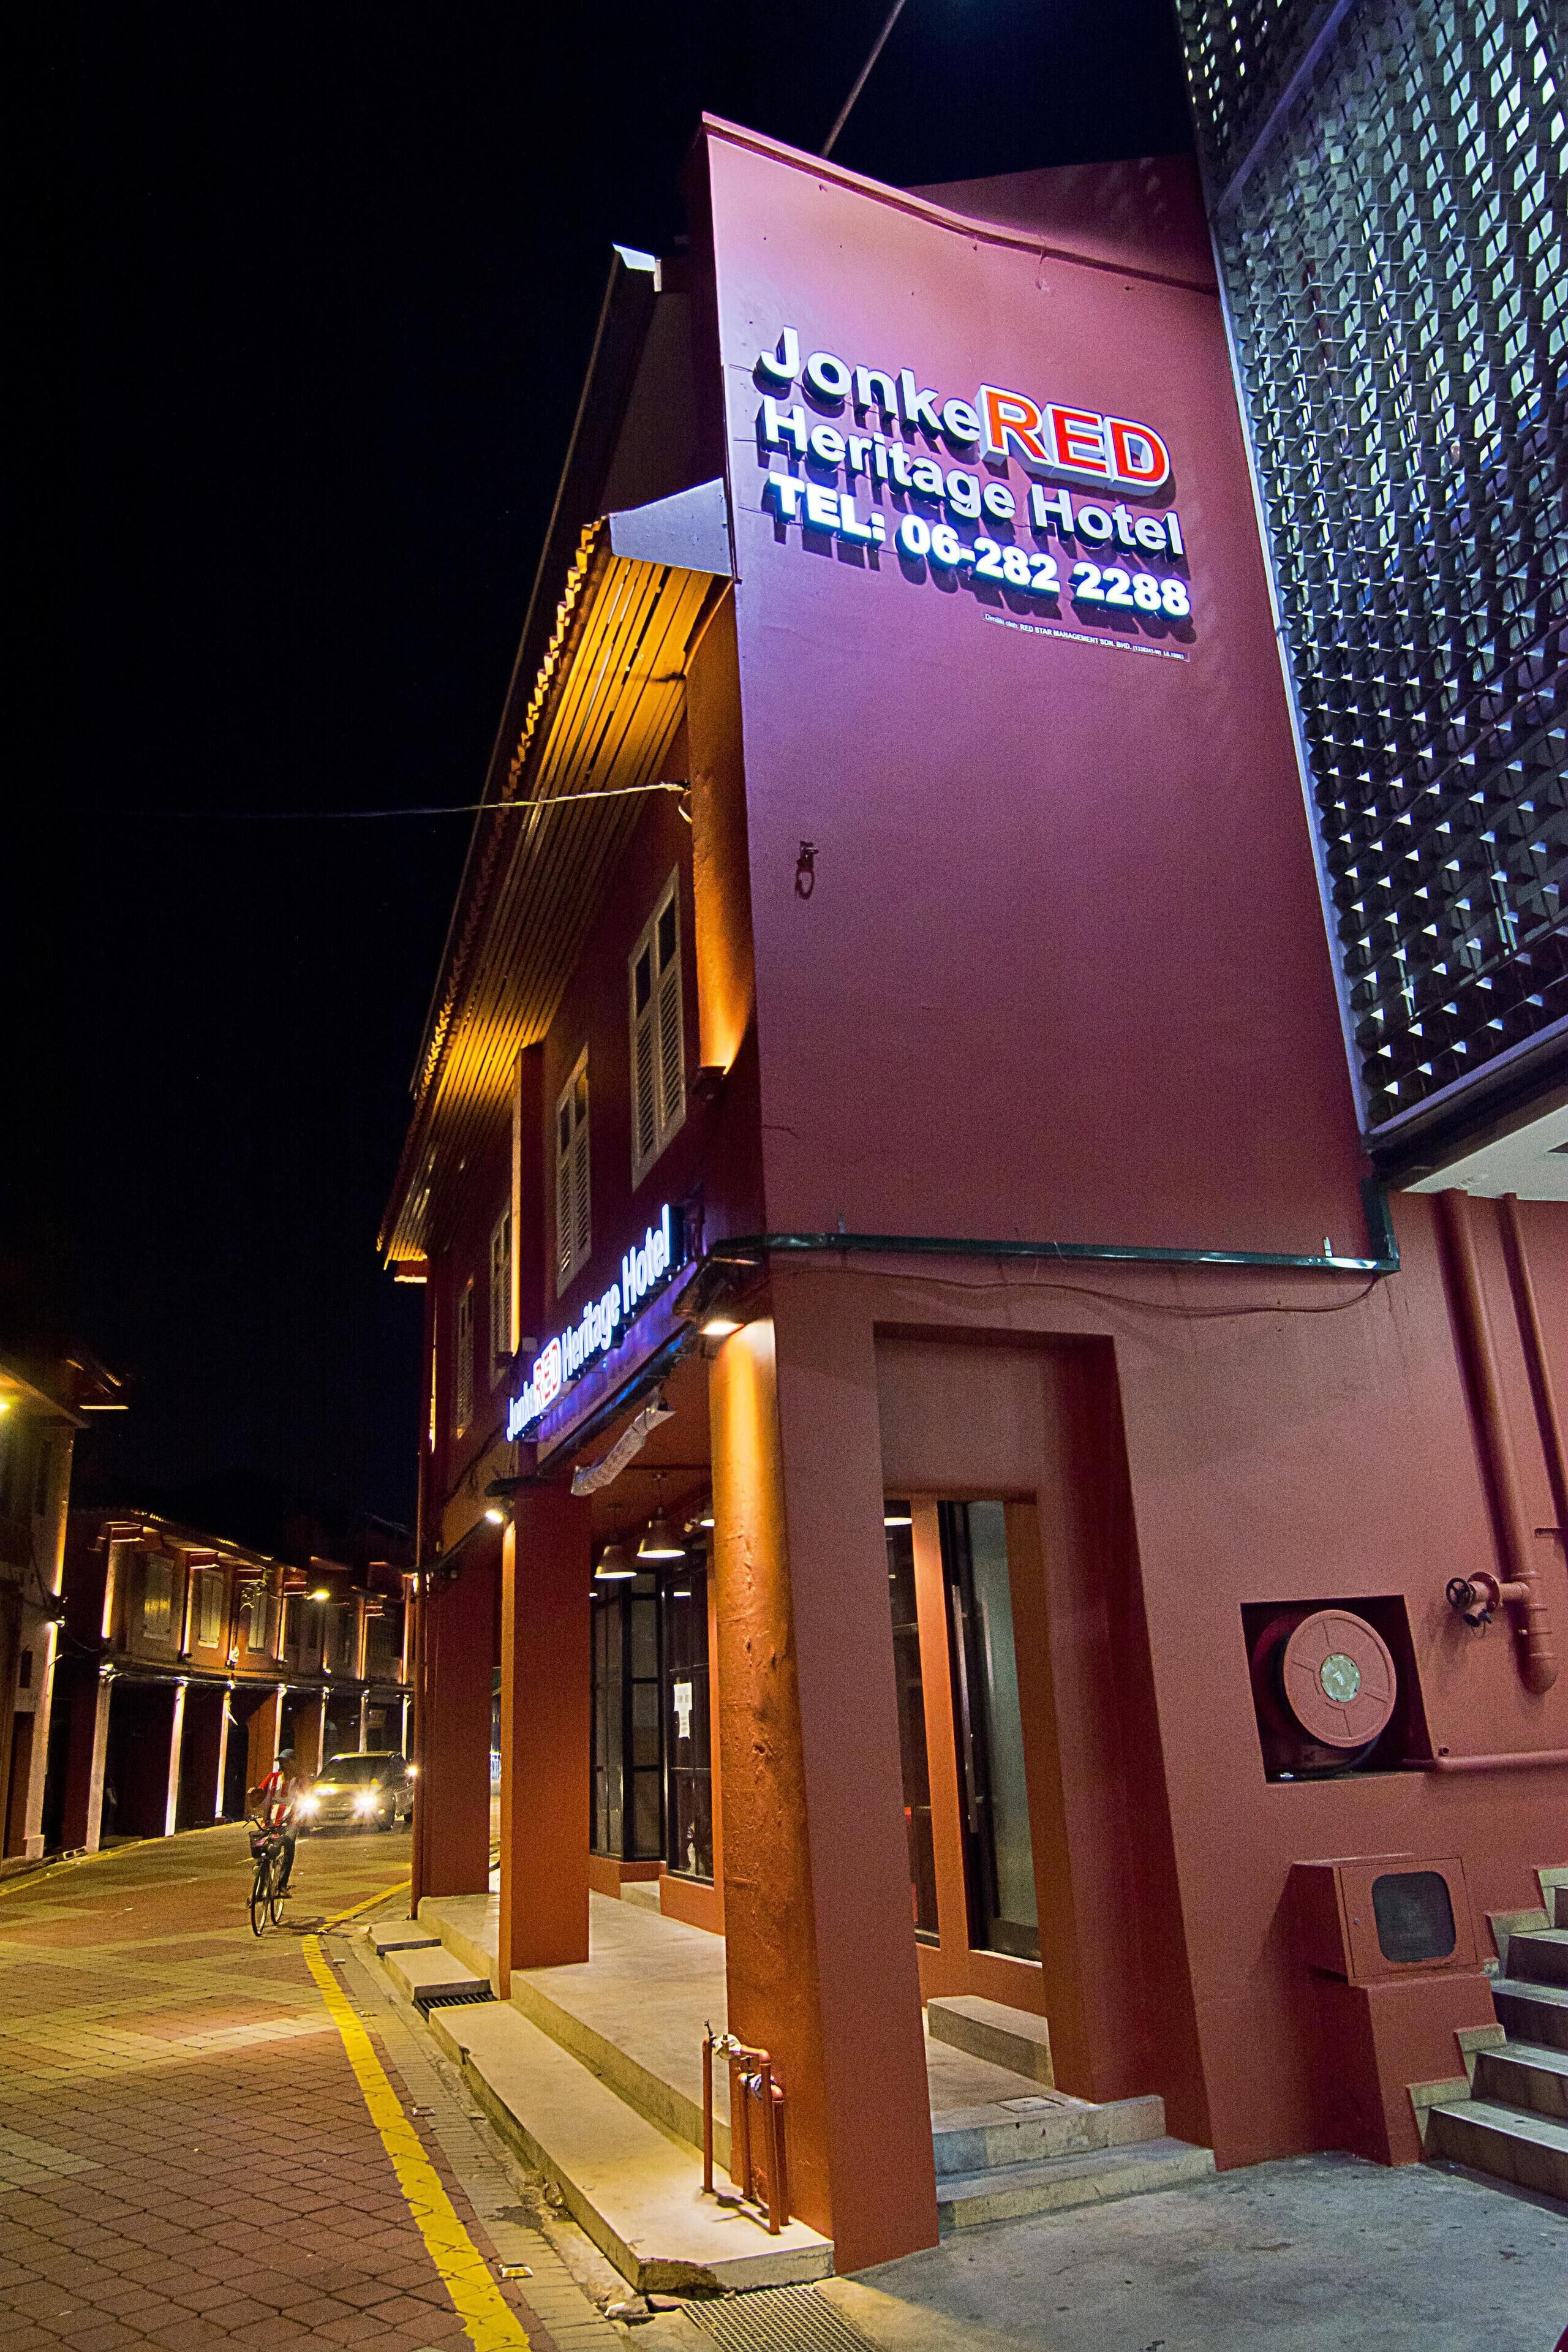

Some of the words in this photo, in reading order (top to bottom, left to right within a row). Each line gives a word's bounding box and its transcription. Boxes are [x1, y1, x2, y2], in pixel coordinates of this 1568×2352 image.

[760, 325, 1171, 488] JonkeRED
[762, 396, 1016, 519] Heritage
[1032, 483, 1184, 556] Hotel
[768, 471, 886, 543] TEL:
[900, 513, 1061, 594] 06-282
[1072, 560, 1192, 617] 2288
[1020, 624, 1033, 633] RED
[1035, 627, 1053, 636] STAR
[1053, 630, 1099, 644] MANAGEMENT
[562, 1284, 620, 1382] Heritage
[622, 1203, 669, 1314] Hotel
